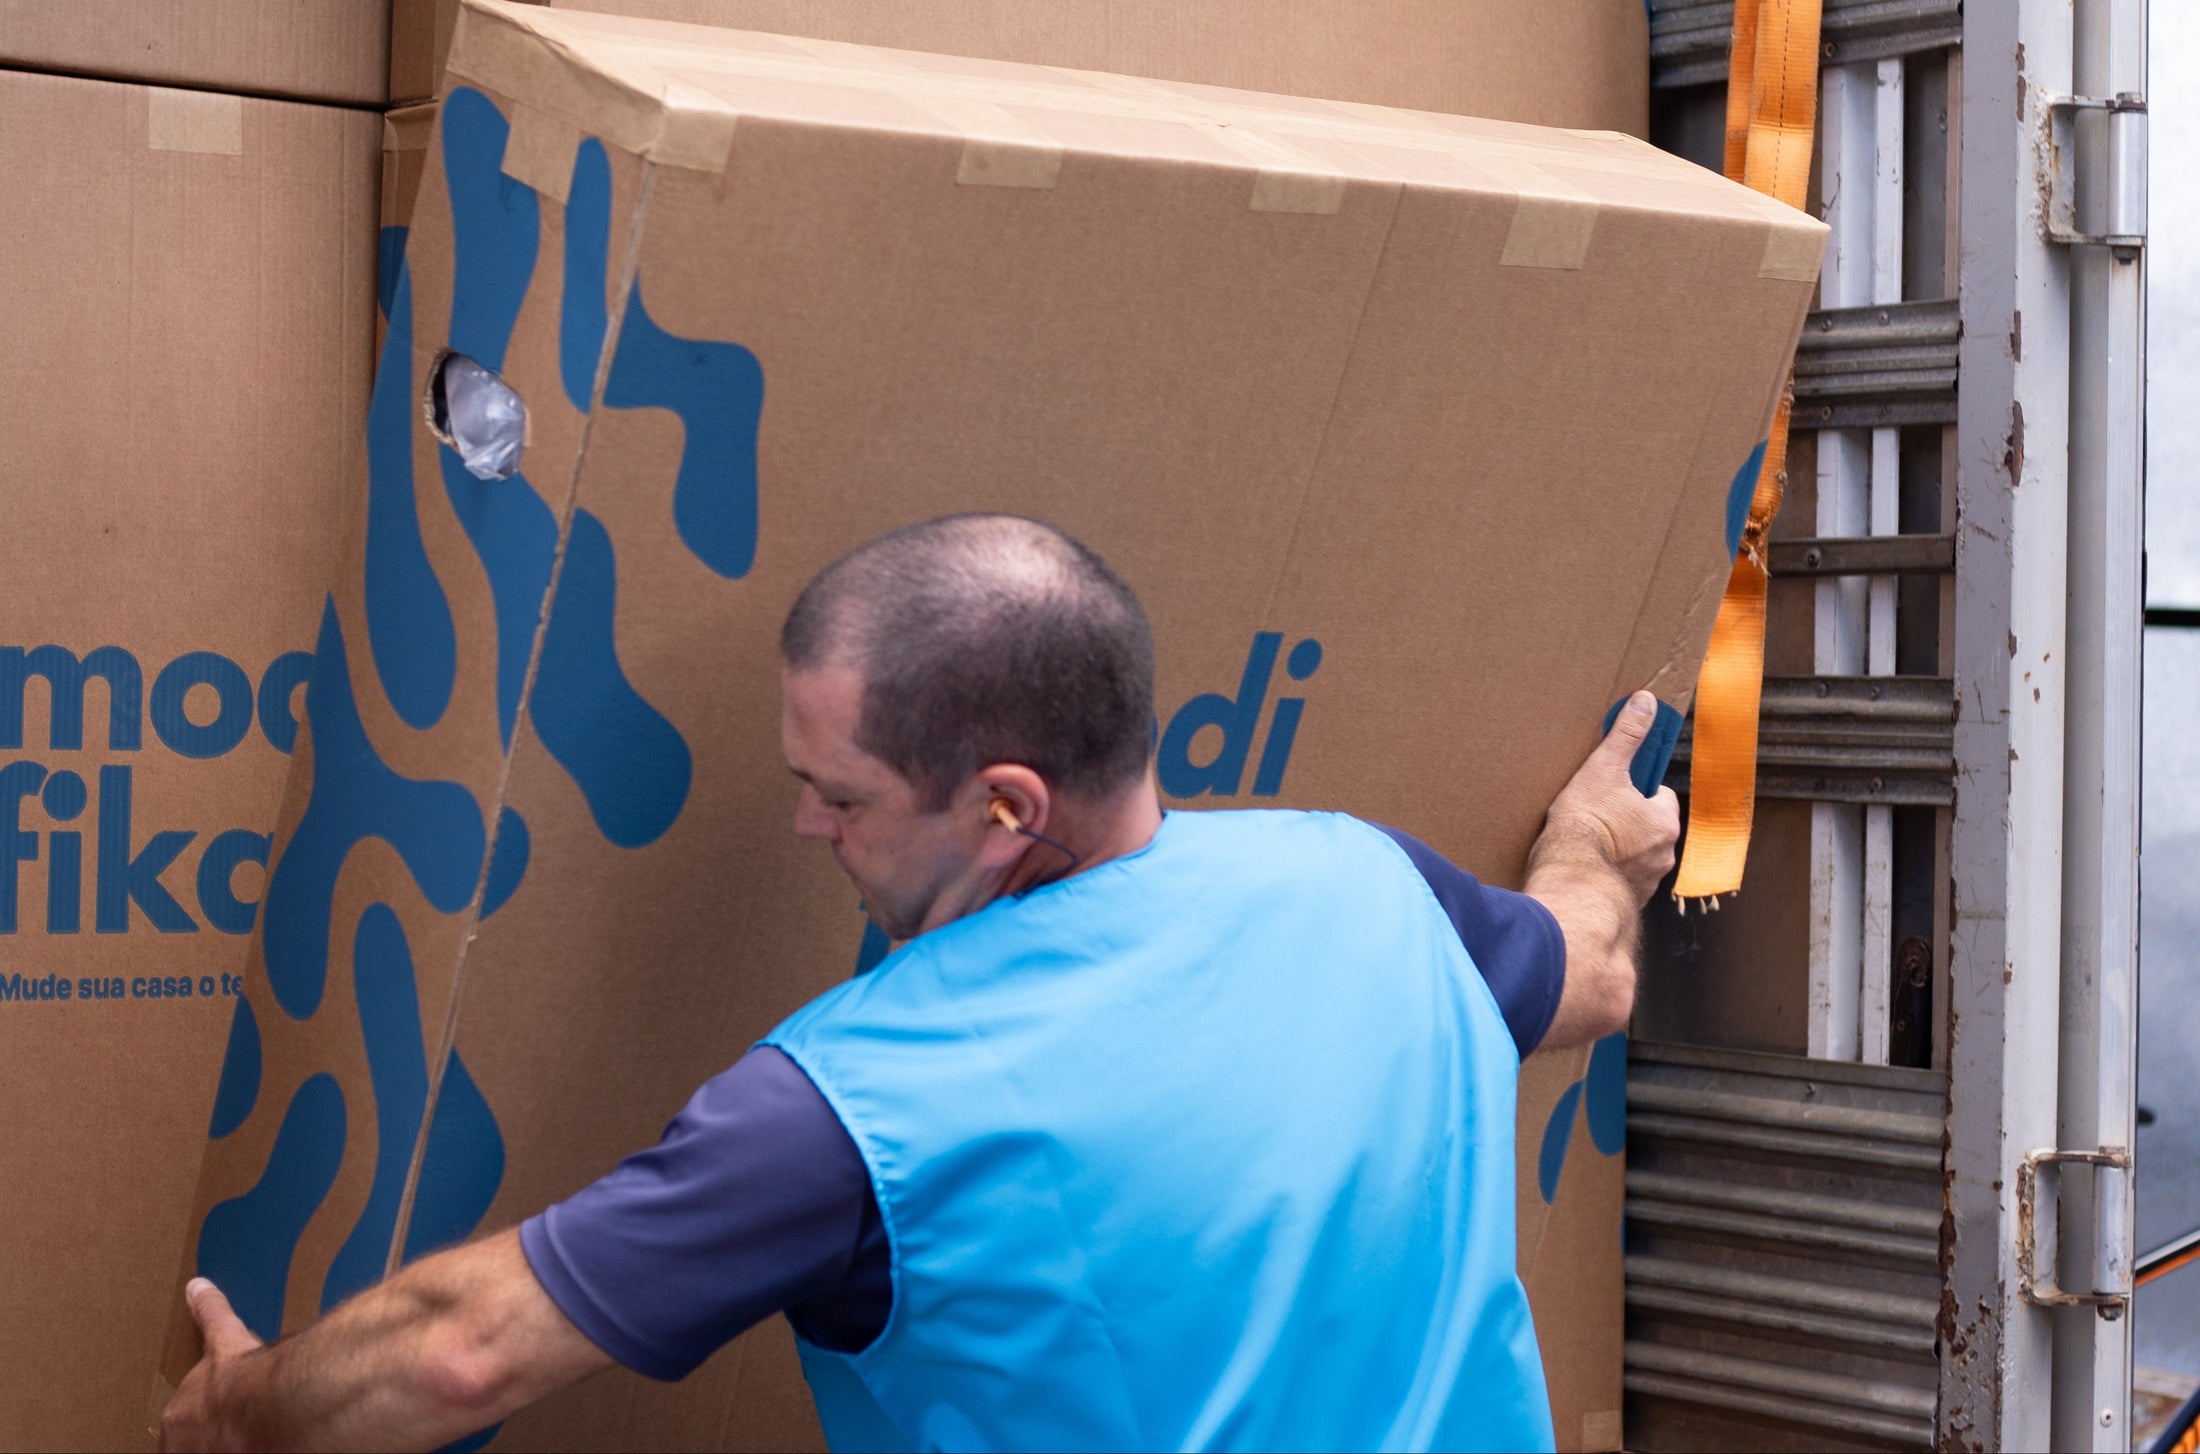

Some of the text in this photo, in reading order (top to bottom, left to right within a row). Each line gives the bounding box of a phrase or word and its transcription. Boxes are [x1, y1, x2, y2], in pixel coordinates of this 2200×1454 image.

[1151, 631, 1323, 799] di
[0, 972, 72, 1001] Mude
[78, 977, 125, 999] sua
[132, 976, 193, 999] casa
[199, 976, 215, 997] o
